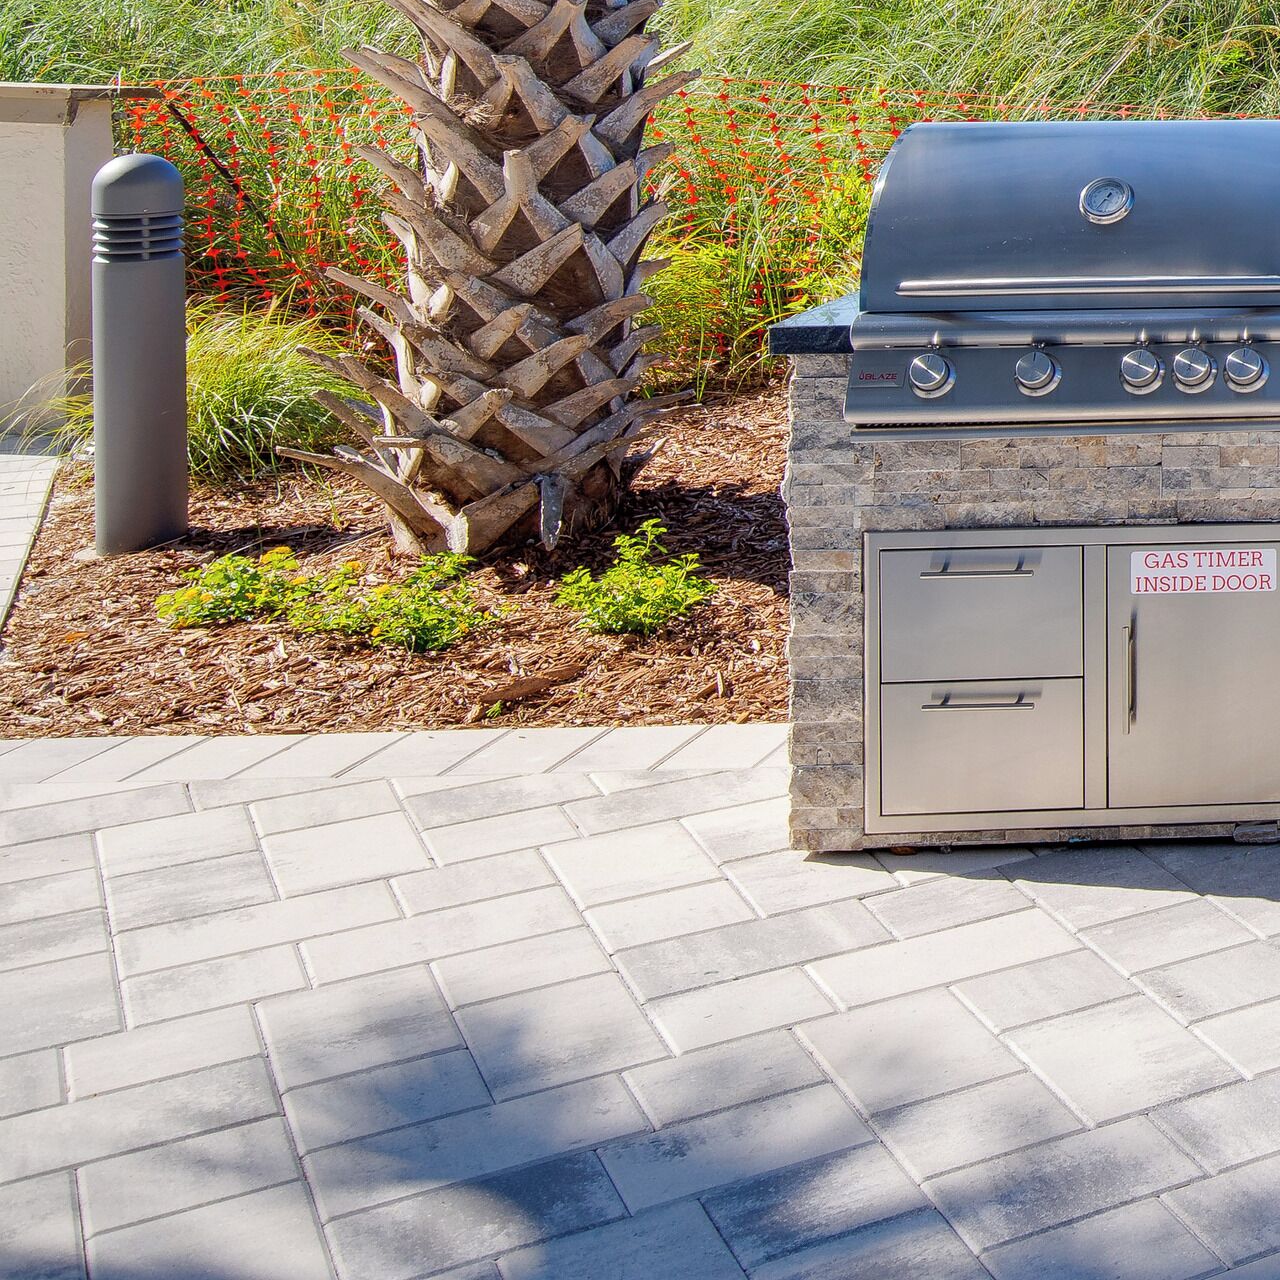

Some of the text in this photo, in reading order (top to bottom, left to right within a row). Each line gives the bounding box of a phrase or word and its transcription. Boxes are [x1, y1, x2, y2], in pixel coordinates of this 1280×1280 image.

[864, 373, 897, 381] BLAZE
[1144, 551, 1264, 569] GAS TIMER
[1135, 574, 1272, 593] INSIDE DOOR
